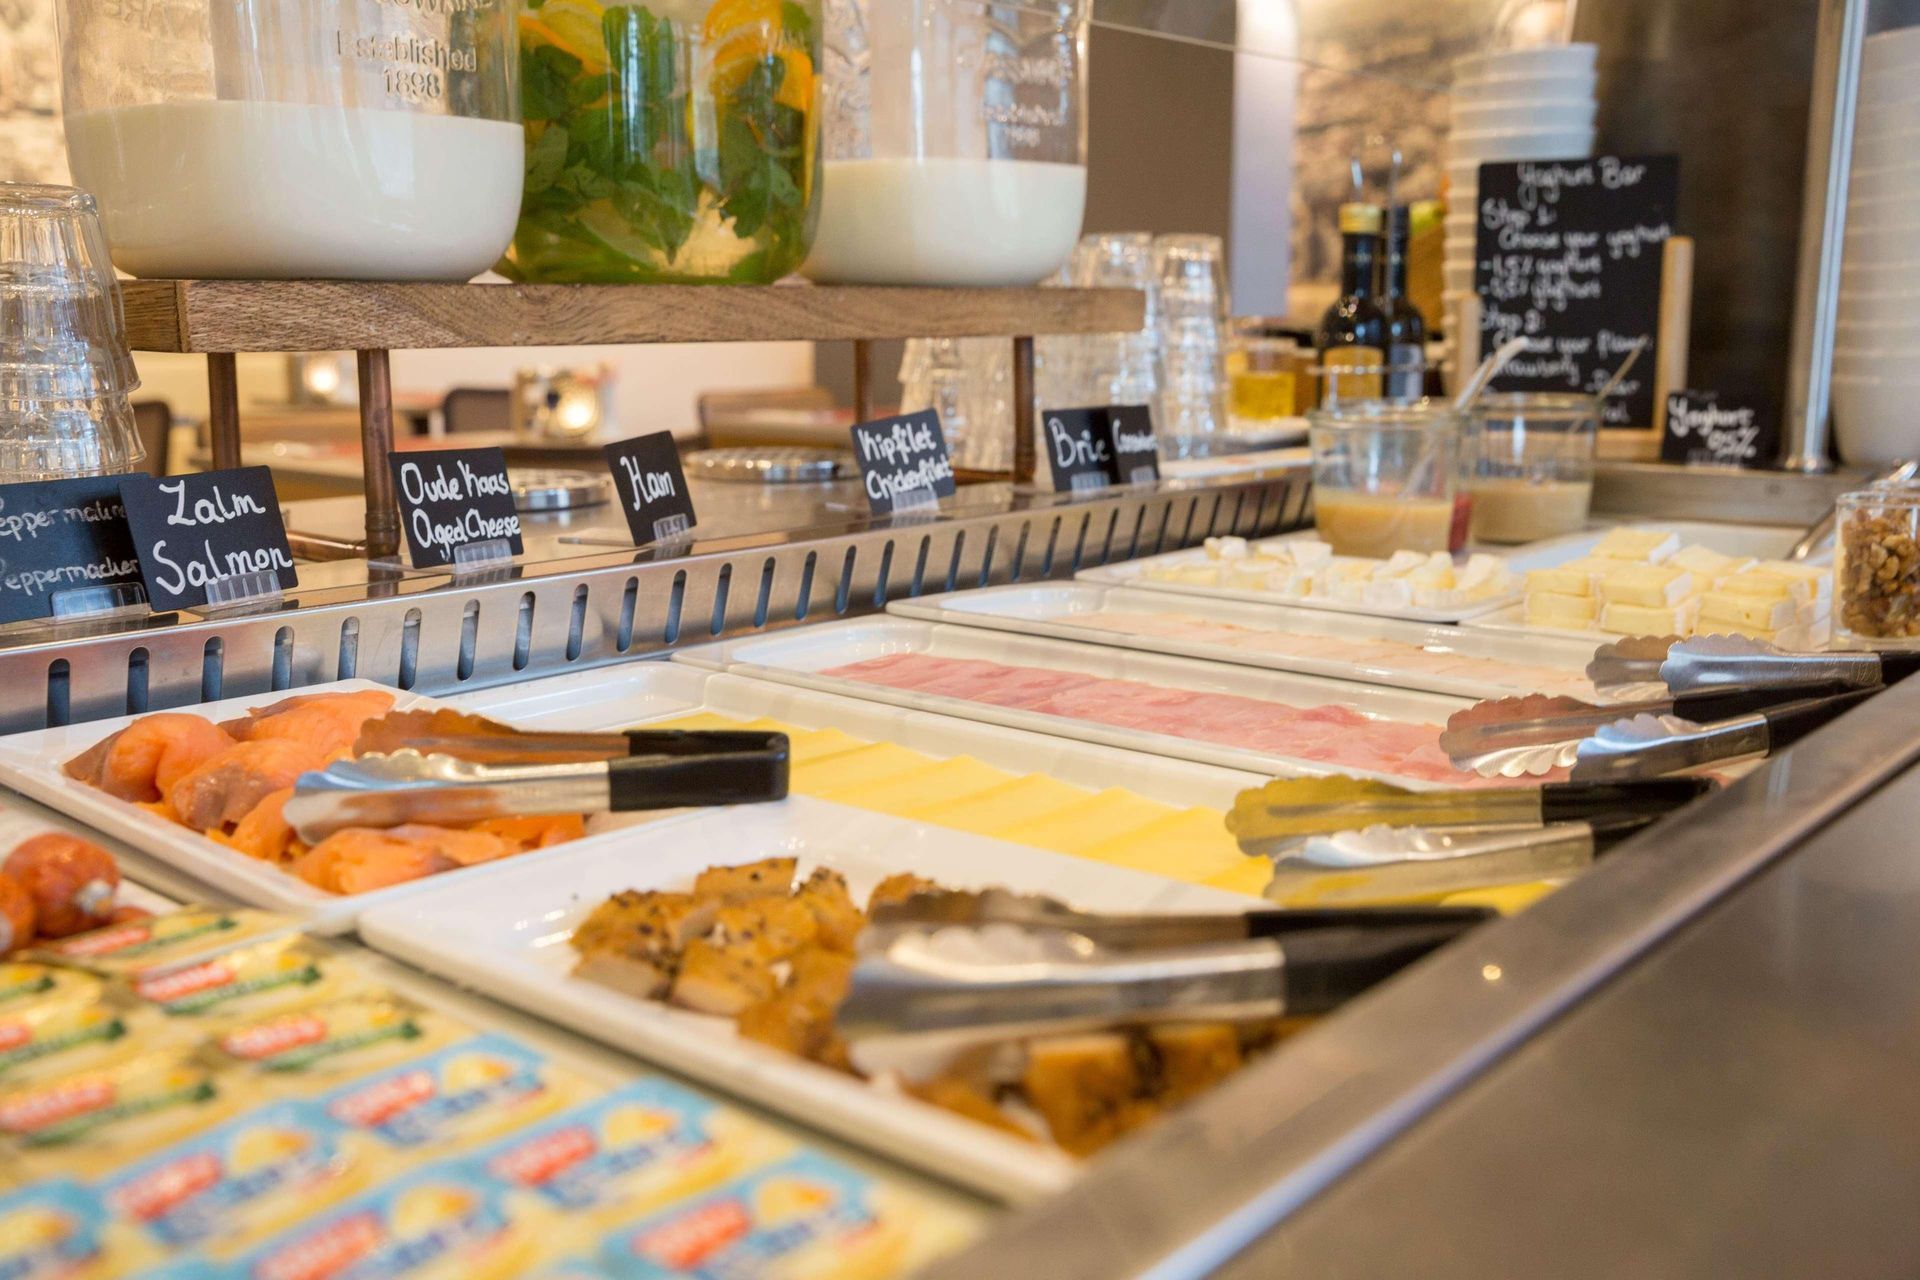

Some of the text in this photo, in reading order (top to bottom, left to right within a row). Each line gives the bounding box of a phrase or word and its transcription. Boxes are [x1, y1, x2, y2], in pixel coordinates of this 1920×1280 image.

[384, 67, 441, 99] 1898
[858, 422, 937, 465] Kipfilet
[1049, 416, 1111, 468] Brie
[158, 479, 267, 527] Zalm
[401, 462, 463, 505] Oude
[620, 455, 676, 512] Ham
[412, 508, 521, 557] Aged Cheese
[152, 539, 294, 596] Salmon
